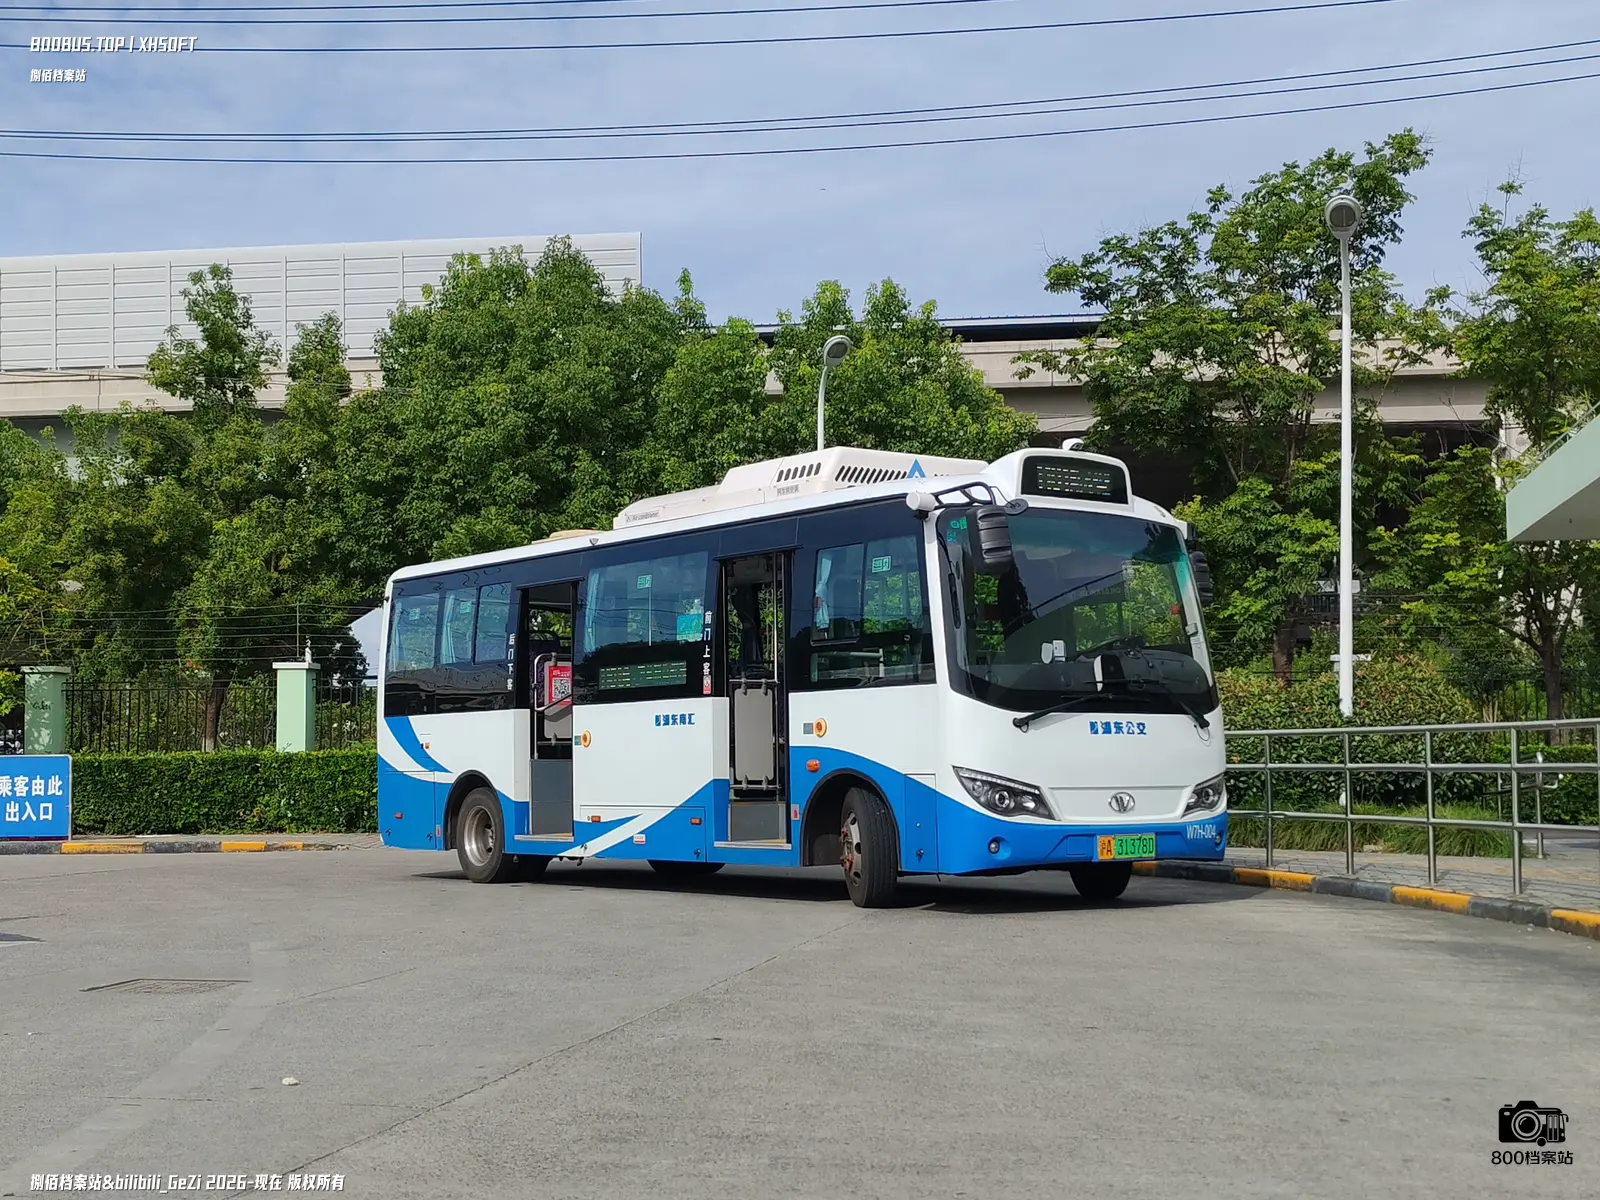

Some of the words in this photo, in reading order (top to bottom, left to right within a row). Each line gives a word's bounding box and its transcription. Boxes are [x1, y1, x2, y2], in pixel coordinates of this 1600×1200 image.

[1100, 721, 1147, 735] 浦东公交
[0, 775, 63, 797] 乘客由此
[5, 801, 53, 822] 出入口
